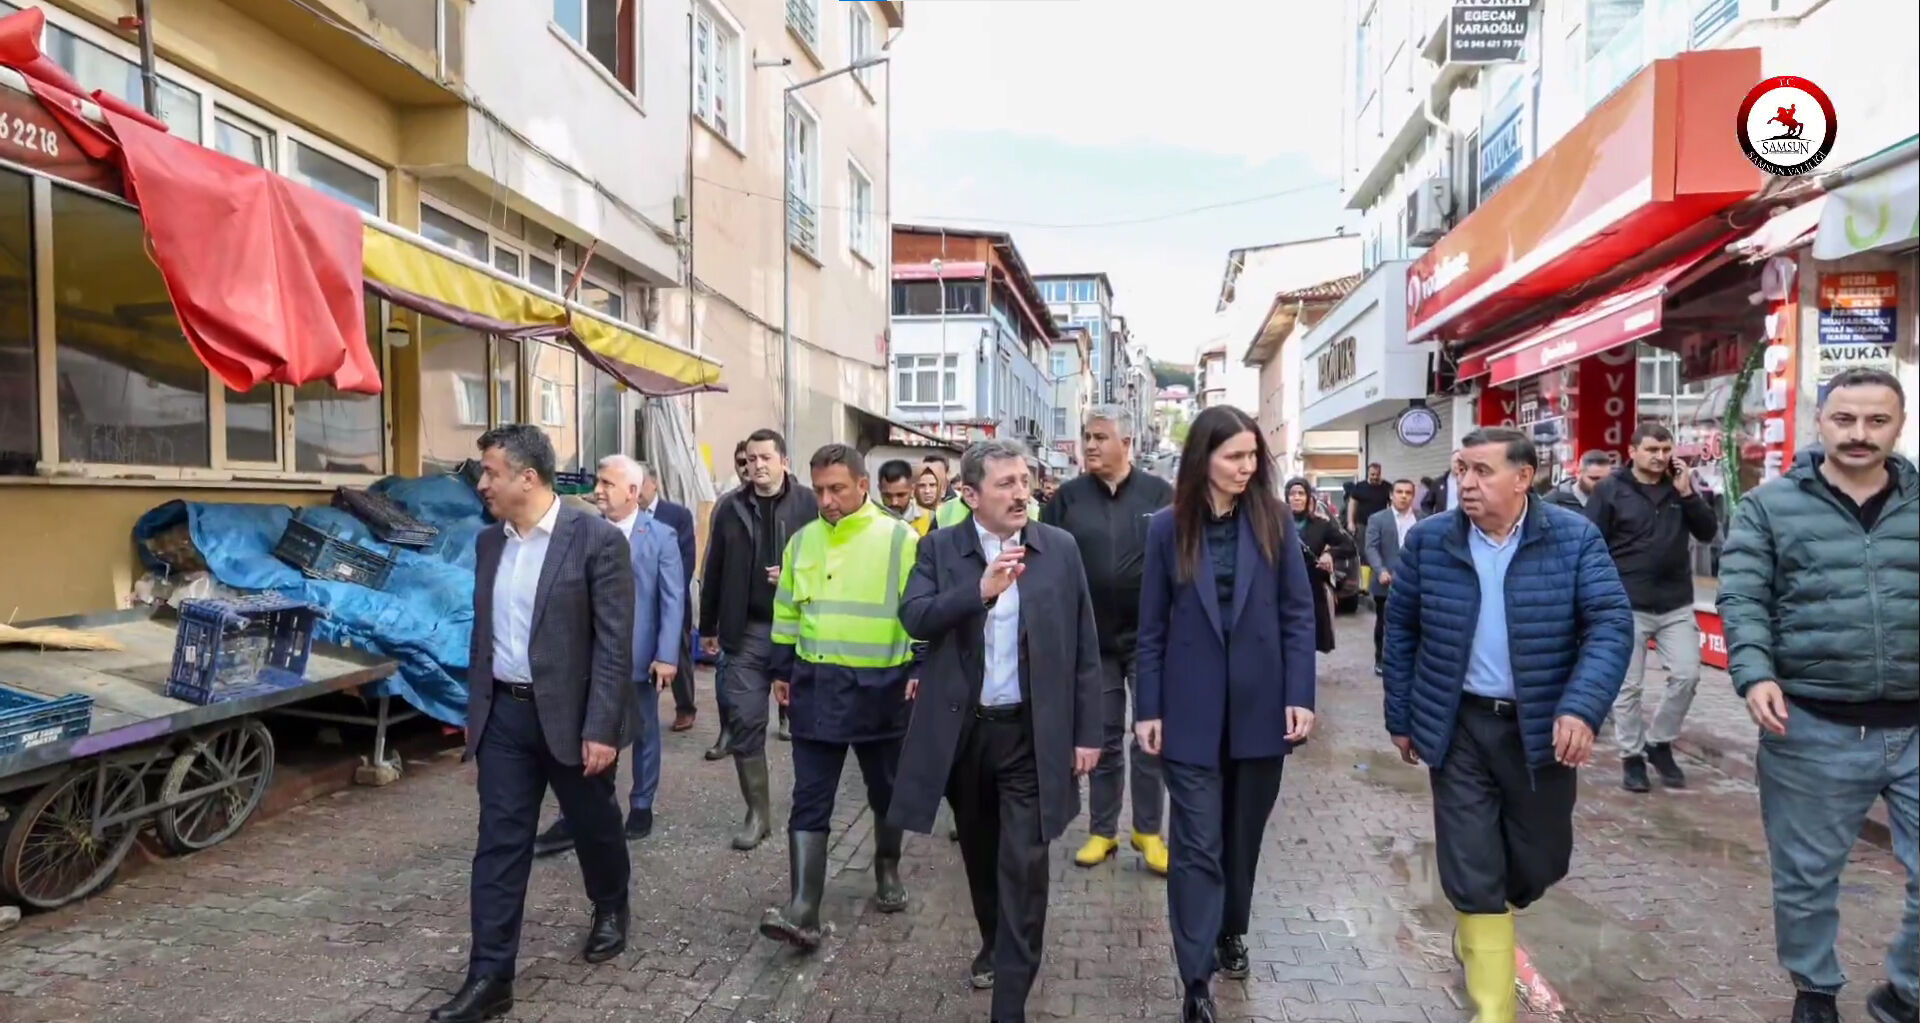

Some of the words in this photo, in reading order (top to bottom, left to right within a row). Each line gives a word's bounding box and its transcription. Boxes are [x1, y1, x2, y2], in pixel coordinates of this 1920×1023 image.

[1464, 10, 1516, 21] EGECAN
[1455, 22, 1525, 35] KARAOĞLU
[1820, 346, 1893, 361] AVUKAT
